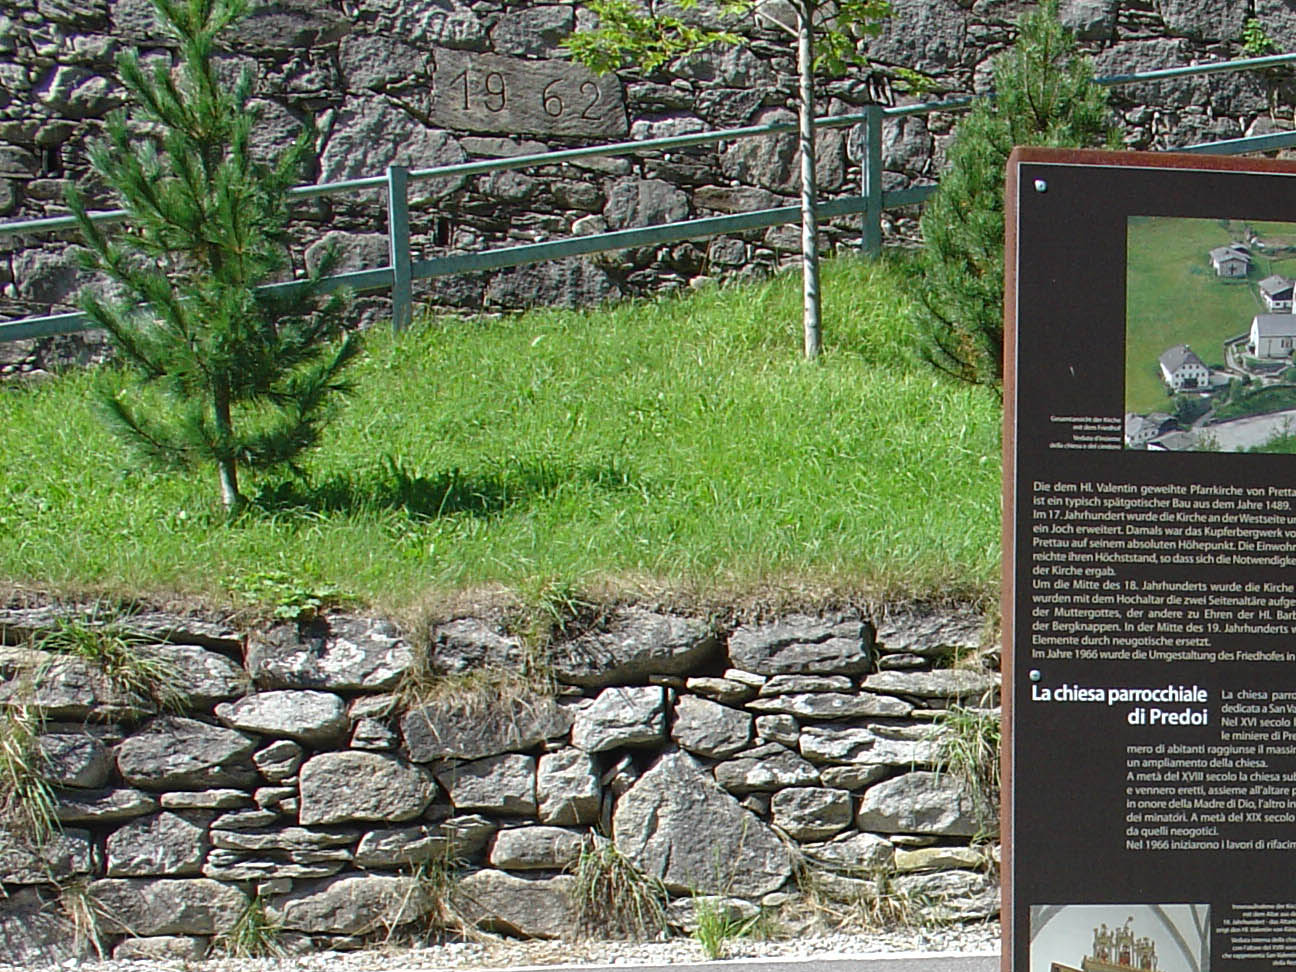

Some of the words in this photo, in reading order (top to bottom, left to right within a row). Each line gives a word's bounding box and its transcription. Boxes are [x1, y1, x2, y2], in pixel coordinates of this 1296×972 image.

[1033, 482, 1050, 491] Die
[1053, 482, 1076, 492] dem
[1096, 483, 1136, 493] Valentin
[1140, 484, 1186, 496] geweihte
[1190, 485, 1242, 495] Pfarrkirche
[1033, 496, 1044, 505] ist
[1047, 496, 1062, 505] ein
[1065, 496, 1100, 508] typisch
[1103, 497, 1169, 510] spätgotischer
[1172, 498, 1190, 508] Bau
[1211, 499, 1234, 509] dem
[1237, 500, 1262, 510] Jahre
[1266, 500, 1291, 510] 1489.
[1033, 523, 1048, 533] ein
[1051, 524, 1073, 533] Joch
[1076, 524, 1124, 534] erweitert.
[1126, 525, 1162, 535] Damals
[1164, 528, 1182, 536] war
[1184, 526, 1201, 536] das
[1204, 527, 1282, 539] Kupferbergwerk
[1033, 537, 1069, 547] Prettau
[1071, 538, 1087, 548] auf
[1089, 538, 1124, 548] seinem
[1127, 539, 1175, 549] absoluten
[1178, 540, 1236, 552] Höhepunkt.
[1238, 541, 1254, 551] Die
[1032, 565, 1048, 575] der
[1051, 565, 1082, 575] Kirche
[1033, 579, 1050, 588] Um
[1054, 579, 1069, 589] die
[1073, 580, 1099, 589] Mitte
[1102, 580, 1120, 590] des
[1125, 580, 1139, 590] 18.
[1142, 581, 1206, 591] Jahrhunderts
[1210, 582, 1241, 592] wurde
[1244, 583, 1260, 592] die
[1263, 583, 1293, 593] Kirche
[1032, 593, 1070, 603] wurden
[1073, 594, 1089, 603] mit
[1091, 594, 1114, 604] dem
[1116, 594, 1163, 604] Hochaltar
[1166, 595, 1181, 605] die
[1184, 595, 1206, 605] zwei
[1208, 596, 1265, 606] Seitenaltäre
[1032, 607, 1049, 616] der
[1126, 608, 1142, 618] der
[1148, 609, 1182, 618] andere
[1204, 609, 1232, 619] Ehren
[1237, 610, 1253, 619] der
[1032, 621, 1048, 630] der
[1124, 622, 1134, 632] In
[1137, 622, 1153, 632] der
[1157, 623, 1182, 632] Mitte
[1186, 623, 1203, 632] des
[1207, 623, 1221, 633] 19.
[1224, 623, 1288, 634] Jahrhunderts
[1032, 635, 1078, 645] Elemente
[1081, 635, 1109, 645] durch
[1112, 636, 1173, 648] neugotische
[1032, 685, 1052, 702] La
[1054, 685, 1105, 702] chiesa
[1107, 685, 1208, 707] parrocchiale
[1222, 690, 1233, 699] La
[1237, 690, 1267, 700] chiesa
[1128, 709, 1146, 726] di
[1150, 709, 1208, 726] Predoi
[1221, 717, 1237, 726] Nel
[1241, 717, 1256, 726] XVI
[1260, 717, 1290, 727] secolo
[1142, 758, 1207, 769] ampliamento
[1209, 758, 1232, 768] della
[1234, 758, 1268, 768] chiesa.
[1127, 771, 1134, 781] A
[1136, 772, 1161, 781] metà
[1163, 772, 1179, 781] del
[1181, 772, 1203, 781] XVIII
[1206, 772, 1236, 781] secolo
[1239, 772, 1247, 781] la
[1249, 772, 1279, 781] chiesa
[1126, 813, 1141, 822] dei
[1190, 813, 1197, 822] A
[1200, 813, 1225, 822] metà
[1228, 813, 1243, 822] del
[1246, 813, 1261, 822] XIX
[1264, 813, 1295, 822] secolo
[1126, 826, 1138, 836] da
[1141, 826, 1168, 838] quelli
